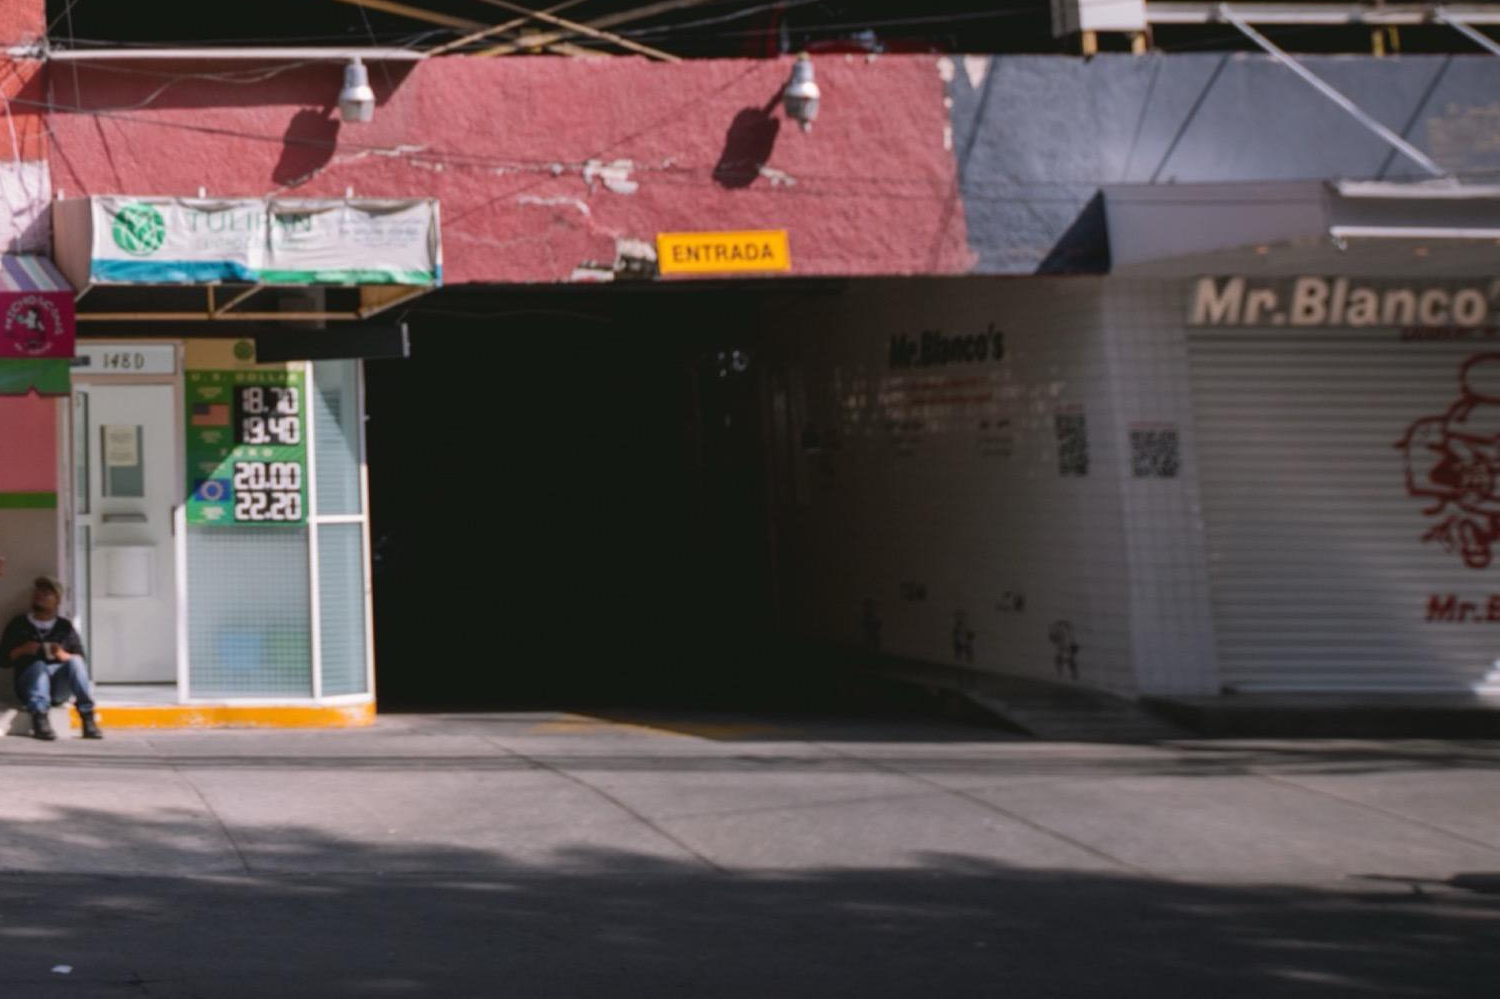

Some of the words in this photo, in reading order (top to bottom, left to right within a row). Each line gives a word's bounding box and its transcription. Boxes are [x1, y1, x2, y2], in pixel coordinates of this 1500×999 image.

[671, 242, 776, 263] ENTRADA
[234, 461, 302, 491] 20.00
[234, 491, 303, 521] 22.20
